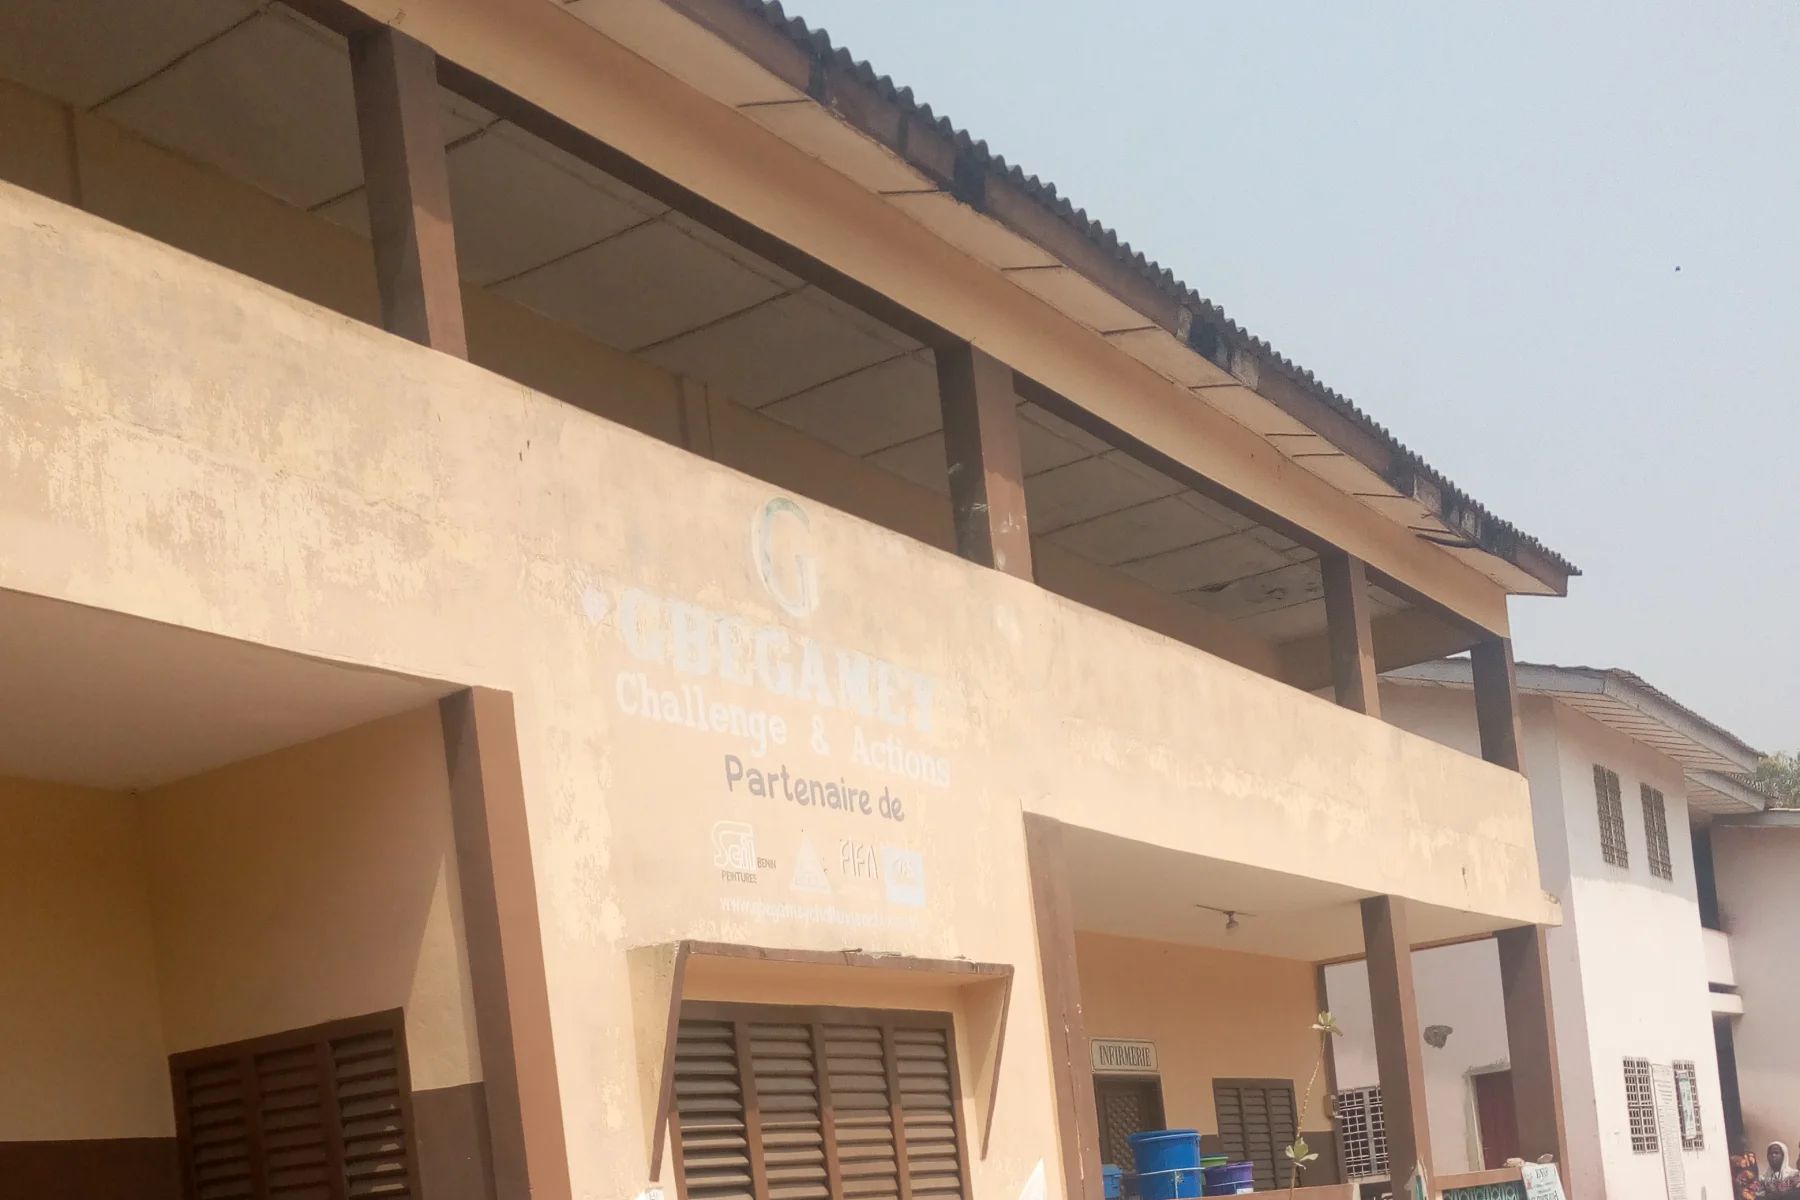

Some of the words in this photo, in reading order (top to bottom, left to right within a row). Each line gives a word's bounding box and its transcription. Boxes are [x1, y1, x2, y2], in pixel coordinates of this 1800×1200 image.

[619, 588, 938, 733] GBEGAMEY
[616, 671, 787, 757] Challenge
[811, 714, 830, 756] &
[852, 726, 951, 788] Actions
[724, 754, 872, 816] Partenaire
[878, 786, 905, 822] de
[721, 869, 758, 883] PEINTURES
[1099, 1045, 1152, 1067] INFIRMERIE
